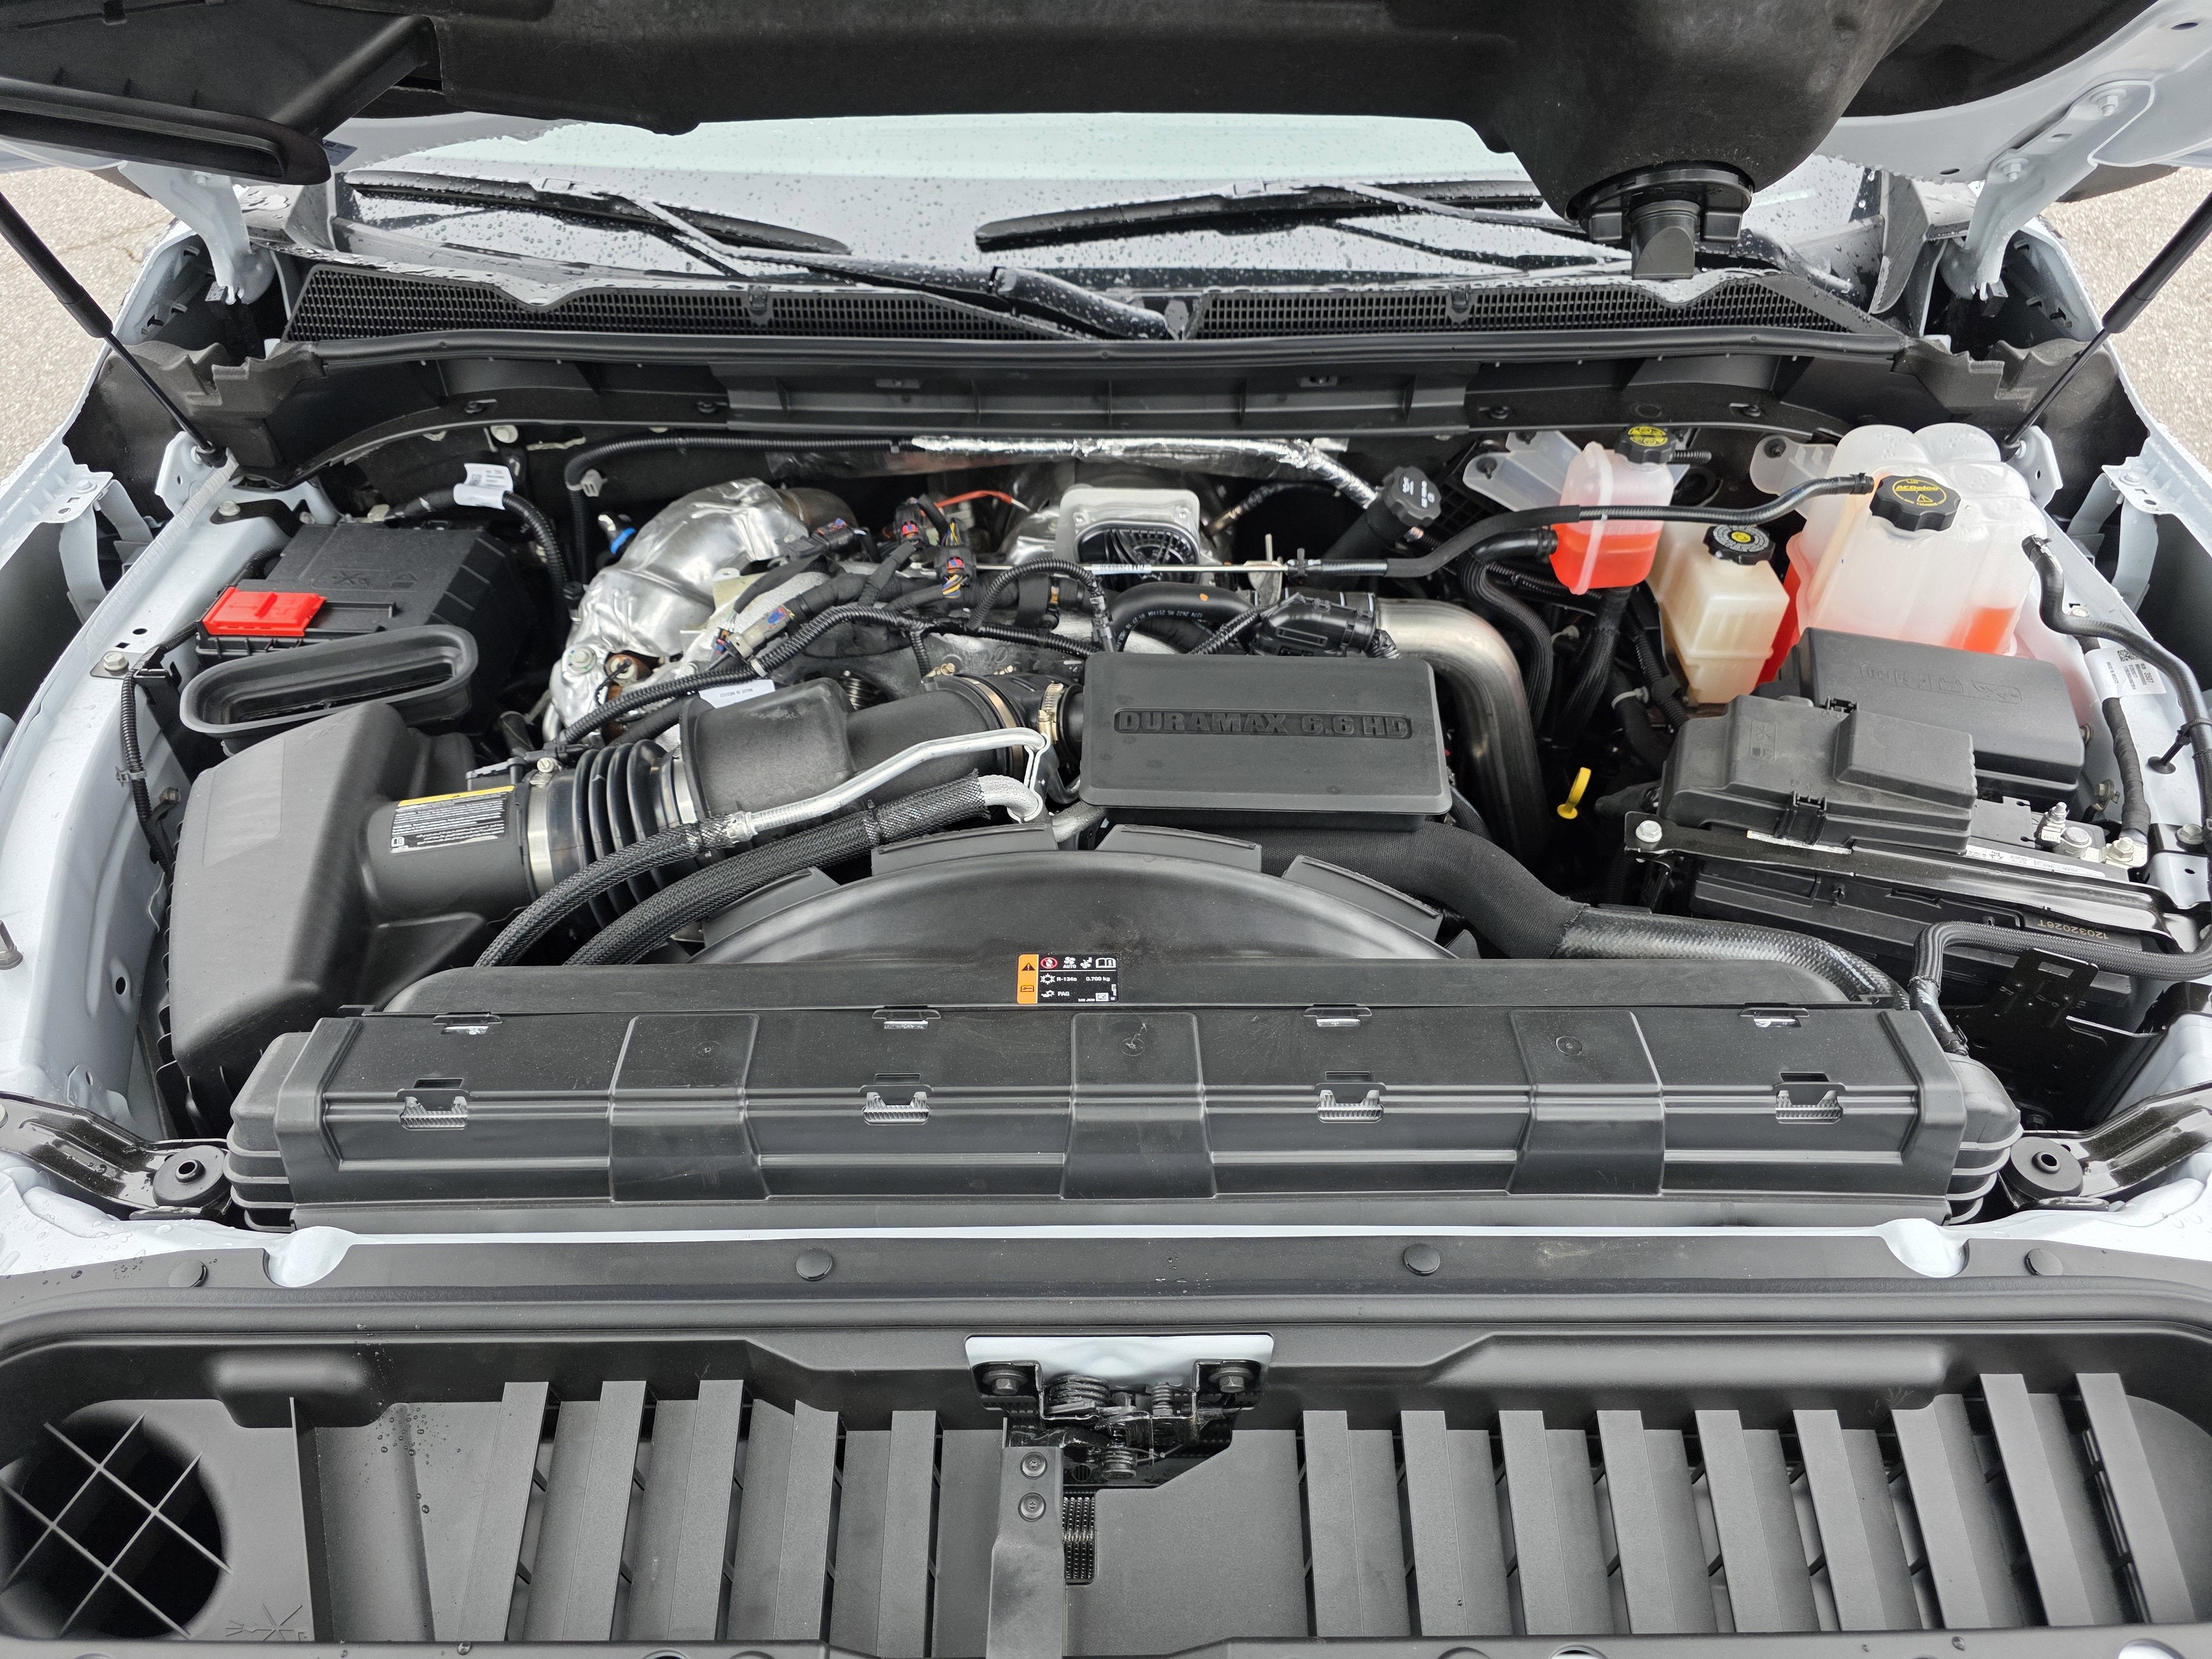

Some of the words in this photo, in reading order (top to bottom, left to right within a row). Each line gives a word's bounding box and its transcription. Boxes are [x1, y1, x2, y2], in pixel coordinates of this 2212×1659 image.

[1118, 711, 1287, 734] DURAMAX
[1302, 714, 1354, 735] 6.6
[1363, 716, 1408, 737] HD
[2037, 919, 2109, 940] 12032026T
